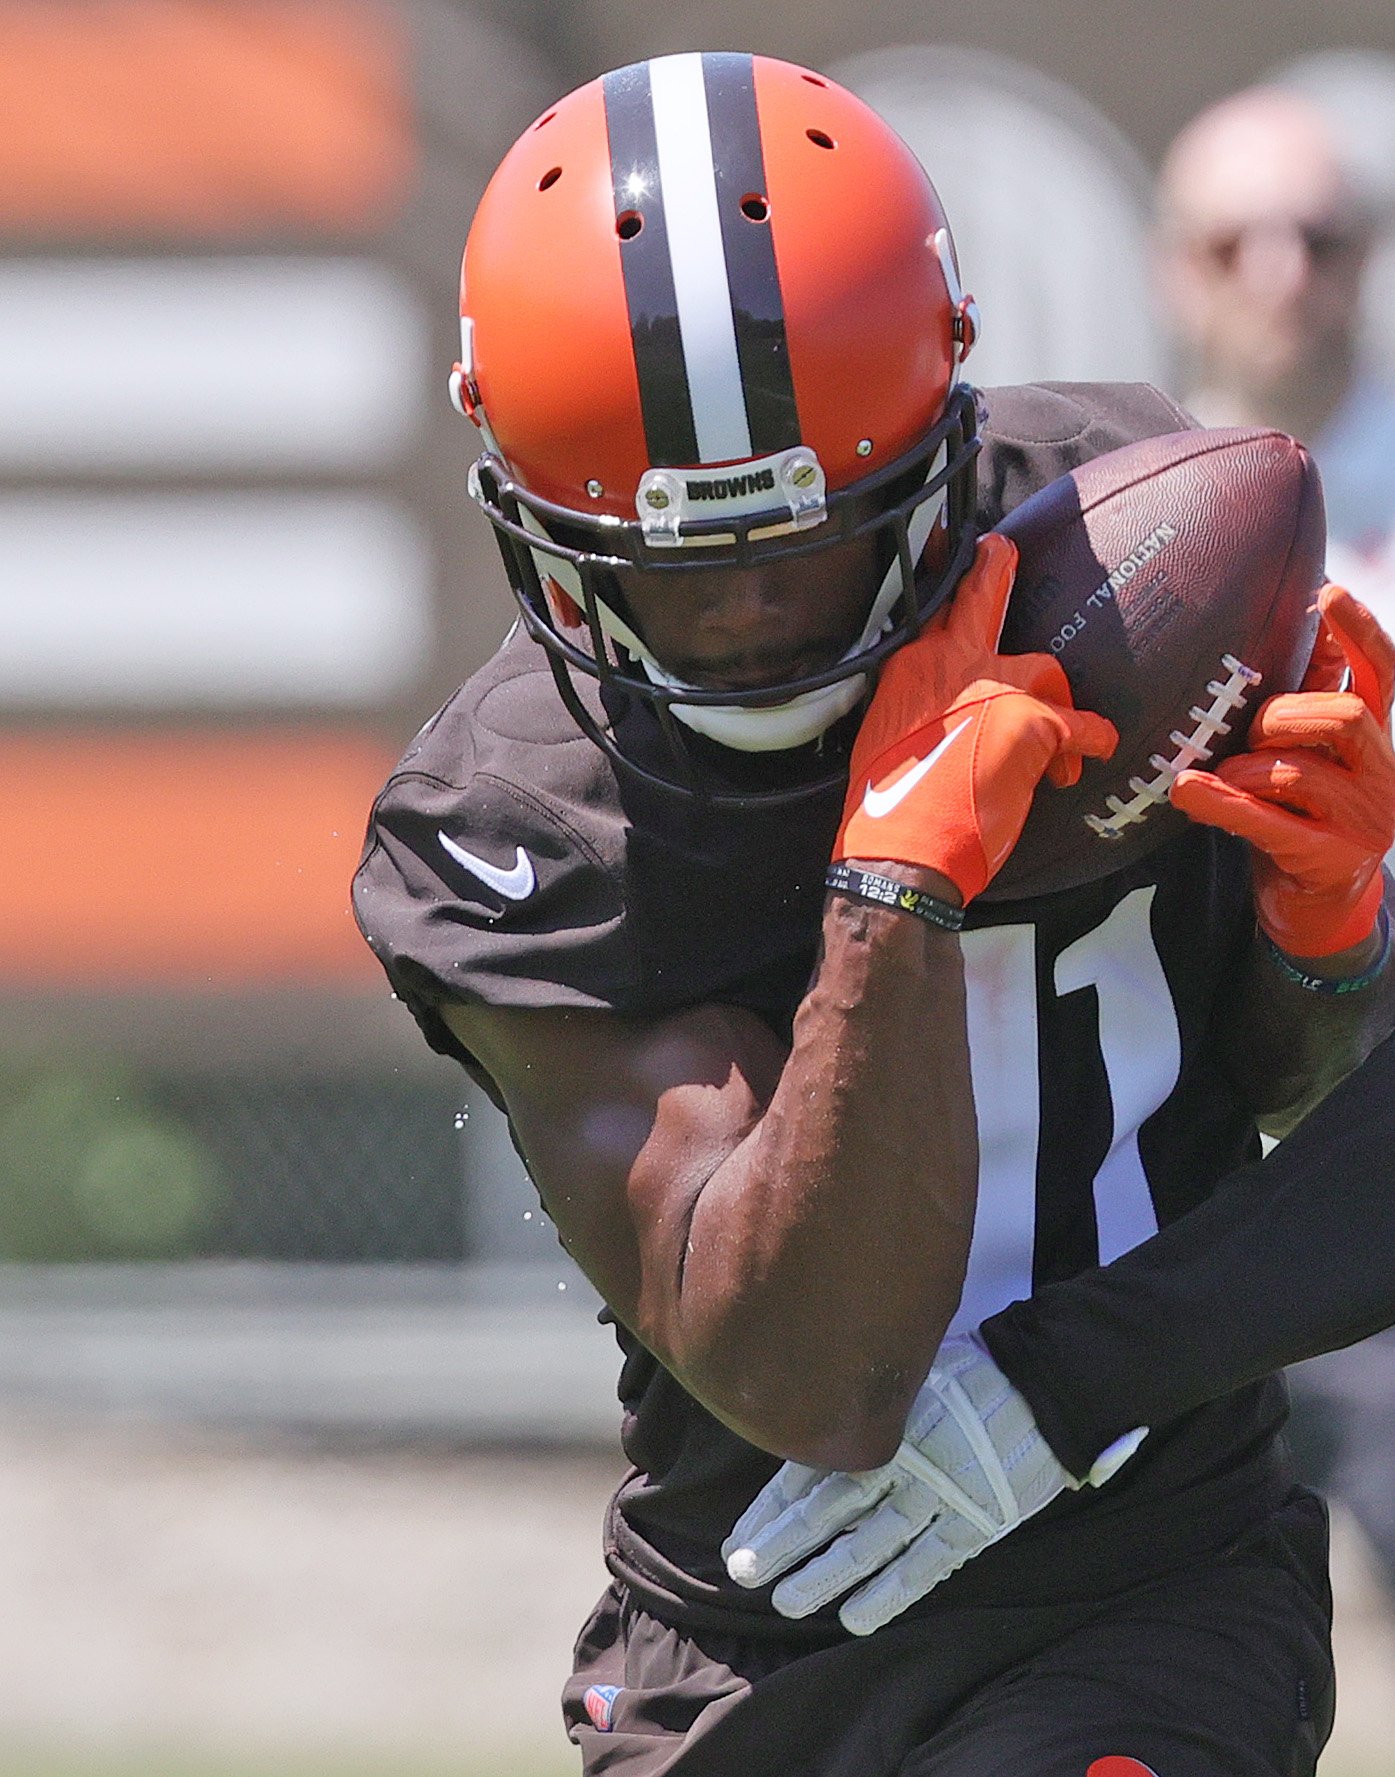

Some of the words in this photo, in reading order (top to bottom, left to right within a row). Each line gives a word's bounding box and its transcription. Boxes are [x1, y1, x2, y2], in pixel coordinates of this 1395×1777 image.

[685, 468, 776, 501] BROWNS
[1086, 521, 1177, 609] NATIONAL
[1050, 611, 1088, 656] FOO
[858, 883, 898, 905] 12:2
[860, 873, 901, 894] ROMANS
[945, 884, 1182, 1335] 11
